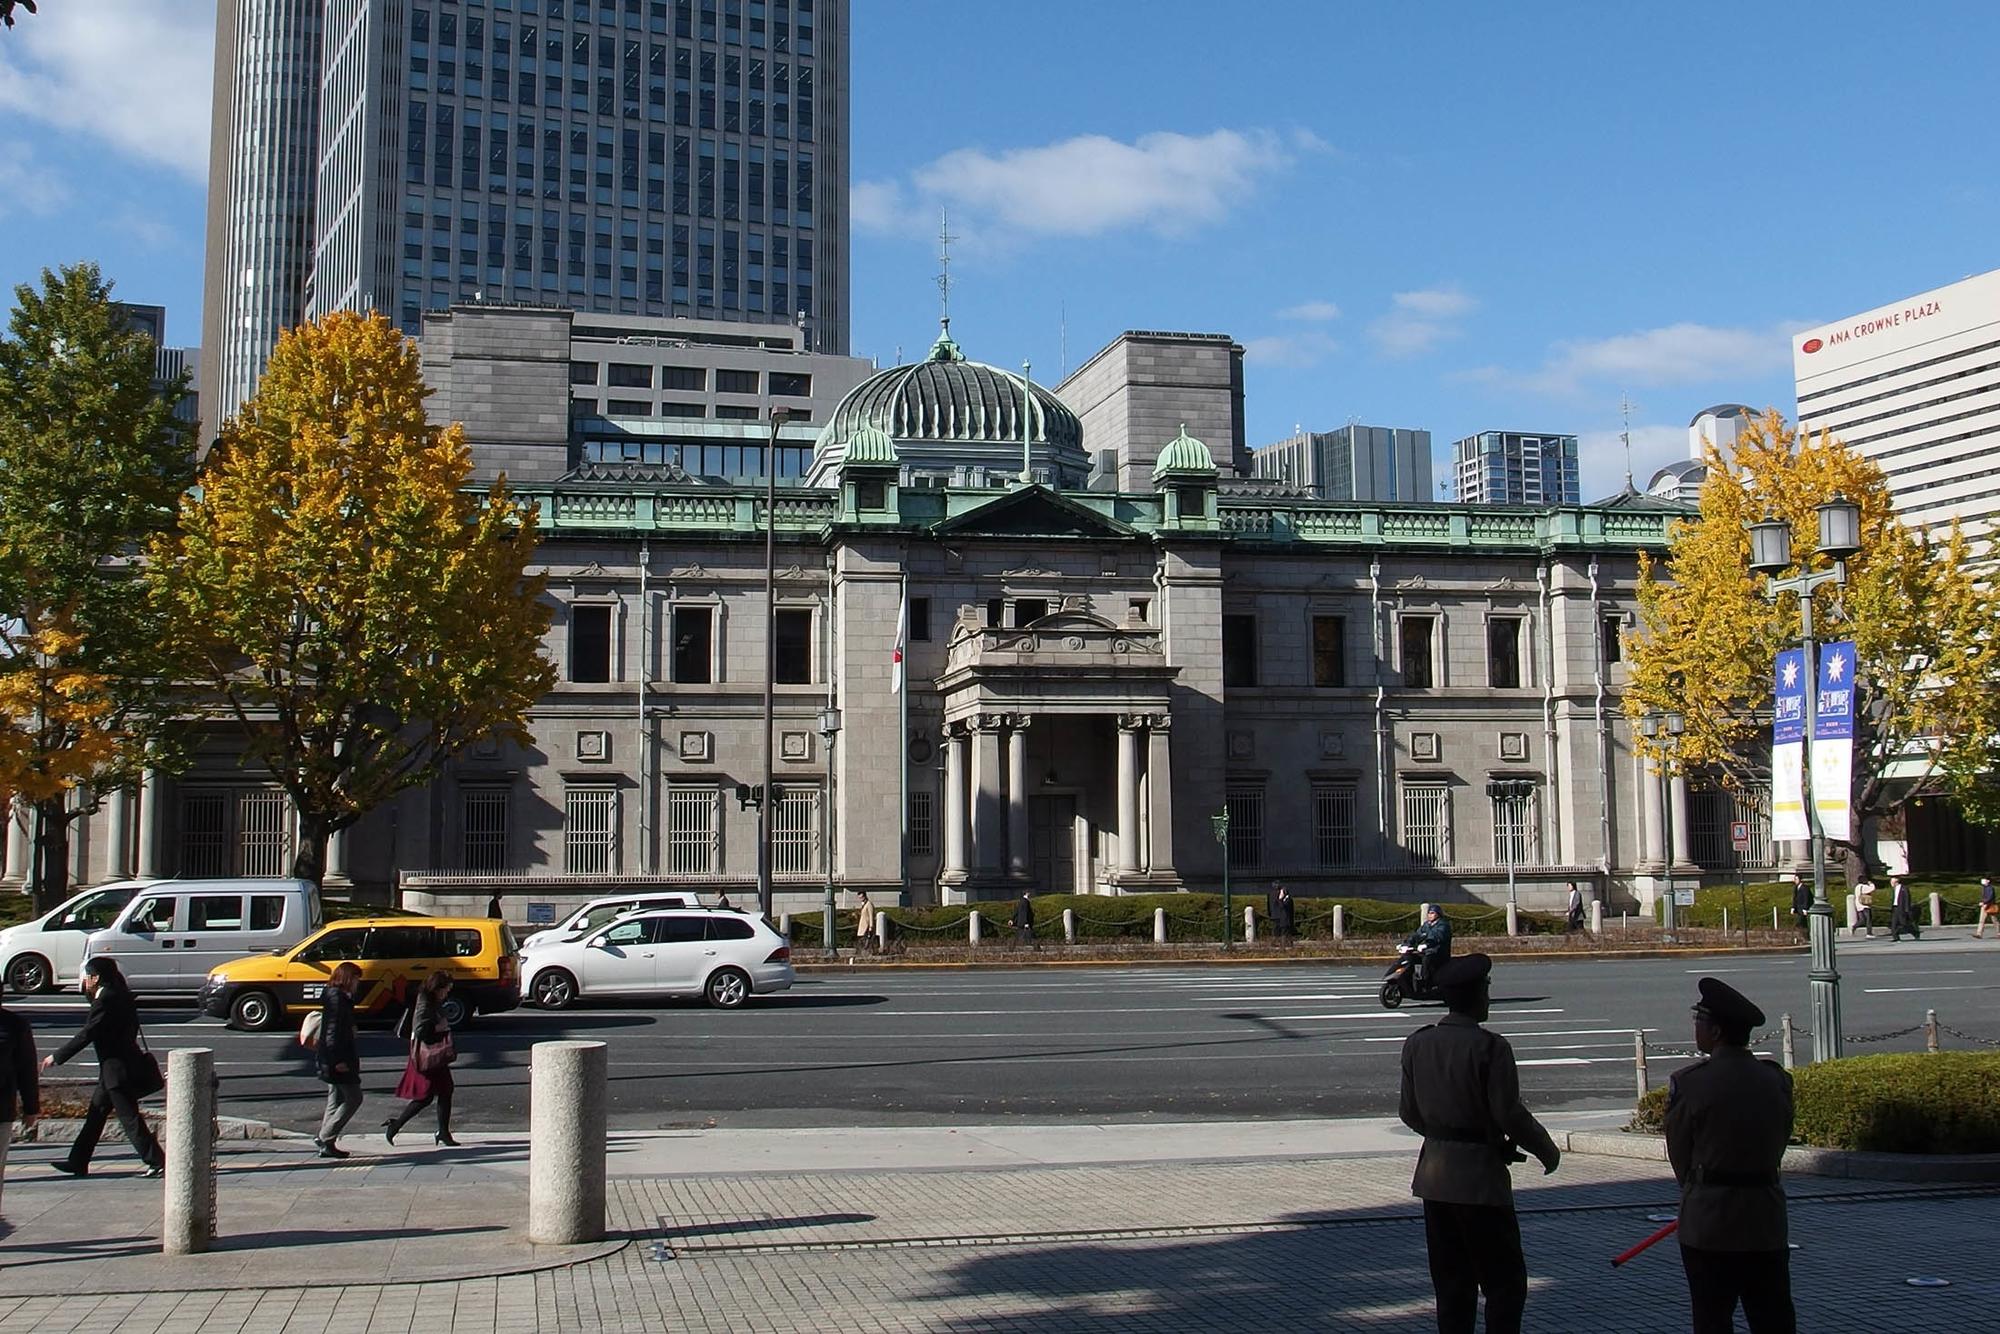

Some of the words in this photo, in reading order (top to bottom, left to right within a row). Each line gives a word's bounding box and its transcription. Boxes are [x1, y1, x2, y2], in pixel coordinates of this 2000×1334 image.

[1829, 330, 1851, 346] ANA
[1854, 314, 1900, 338] CROWNE
[1905, 302, 1940, 322] PLAZA
